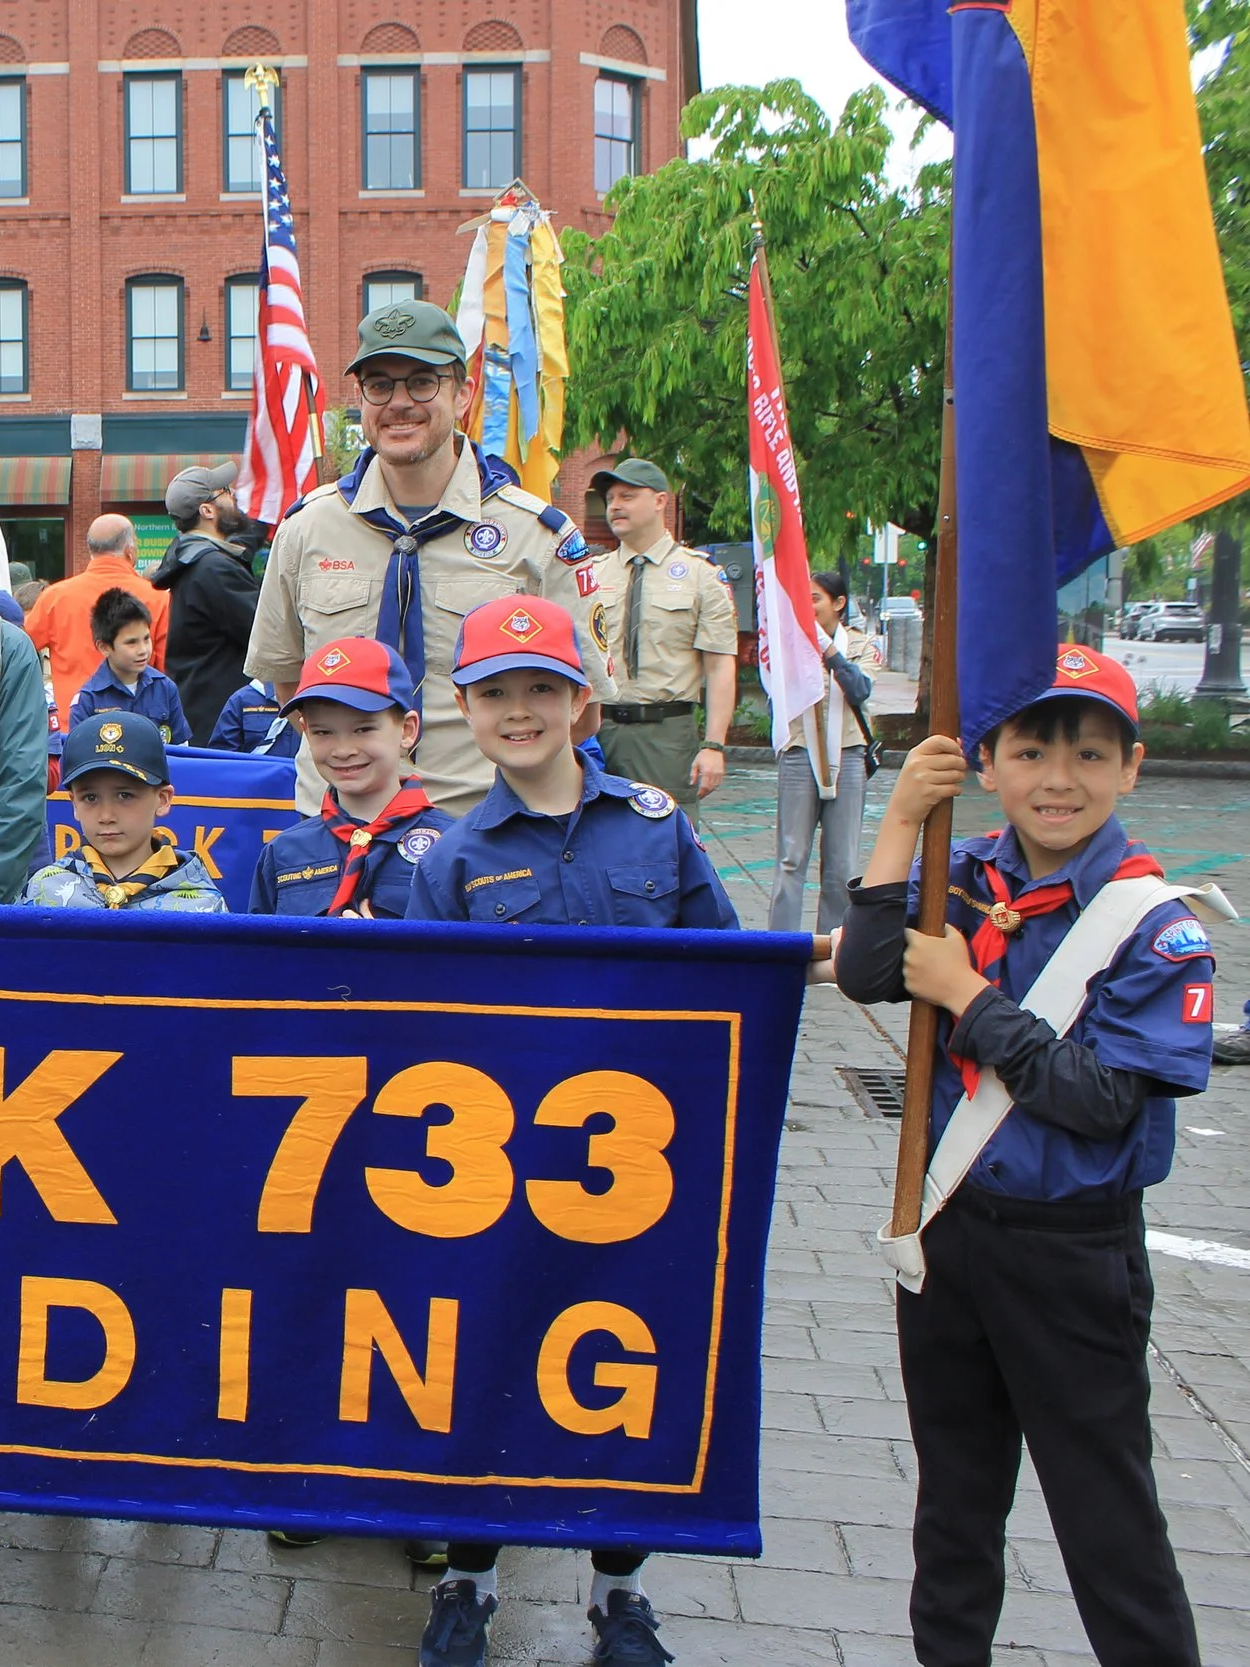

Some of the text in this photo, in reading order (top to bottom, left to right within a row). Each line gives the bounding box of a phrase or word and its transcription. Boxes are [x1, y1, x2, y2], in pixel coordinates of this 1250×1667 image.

[754, 393, 784, 452] RIFLE
[776, 447, 798, 493] AND
[135, 523, 170, 531] Northern
[332, 560, 355, 570] BSA
[95, 744, 116, 753] LION
[314, 865, 338, 876] AMERICA
[470, 876, 495, 889] SCOUTS
[503, 868, 533, 881] AMERICA
[948, 885, 963, 896] BOY
[1165, 921, 1185, 941] SPIRIT
[1187, 988, 1205, 1017] 7
[231, 1056, 676, 1244] 733
